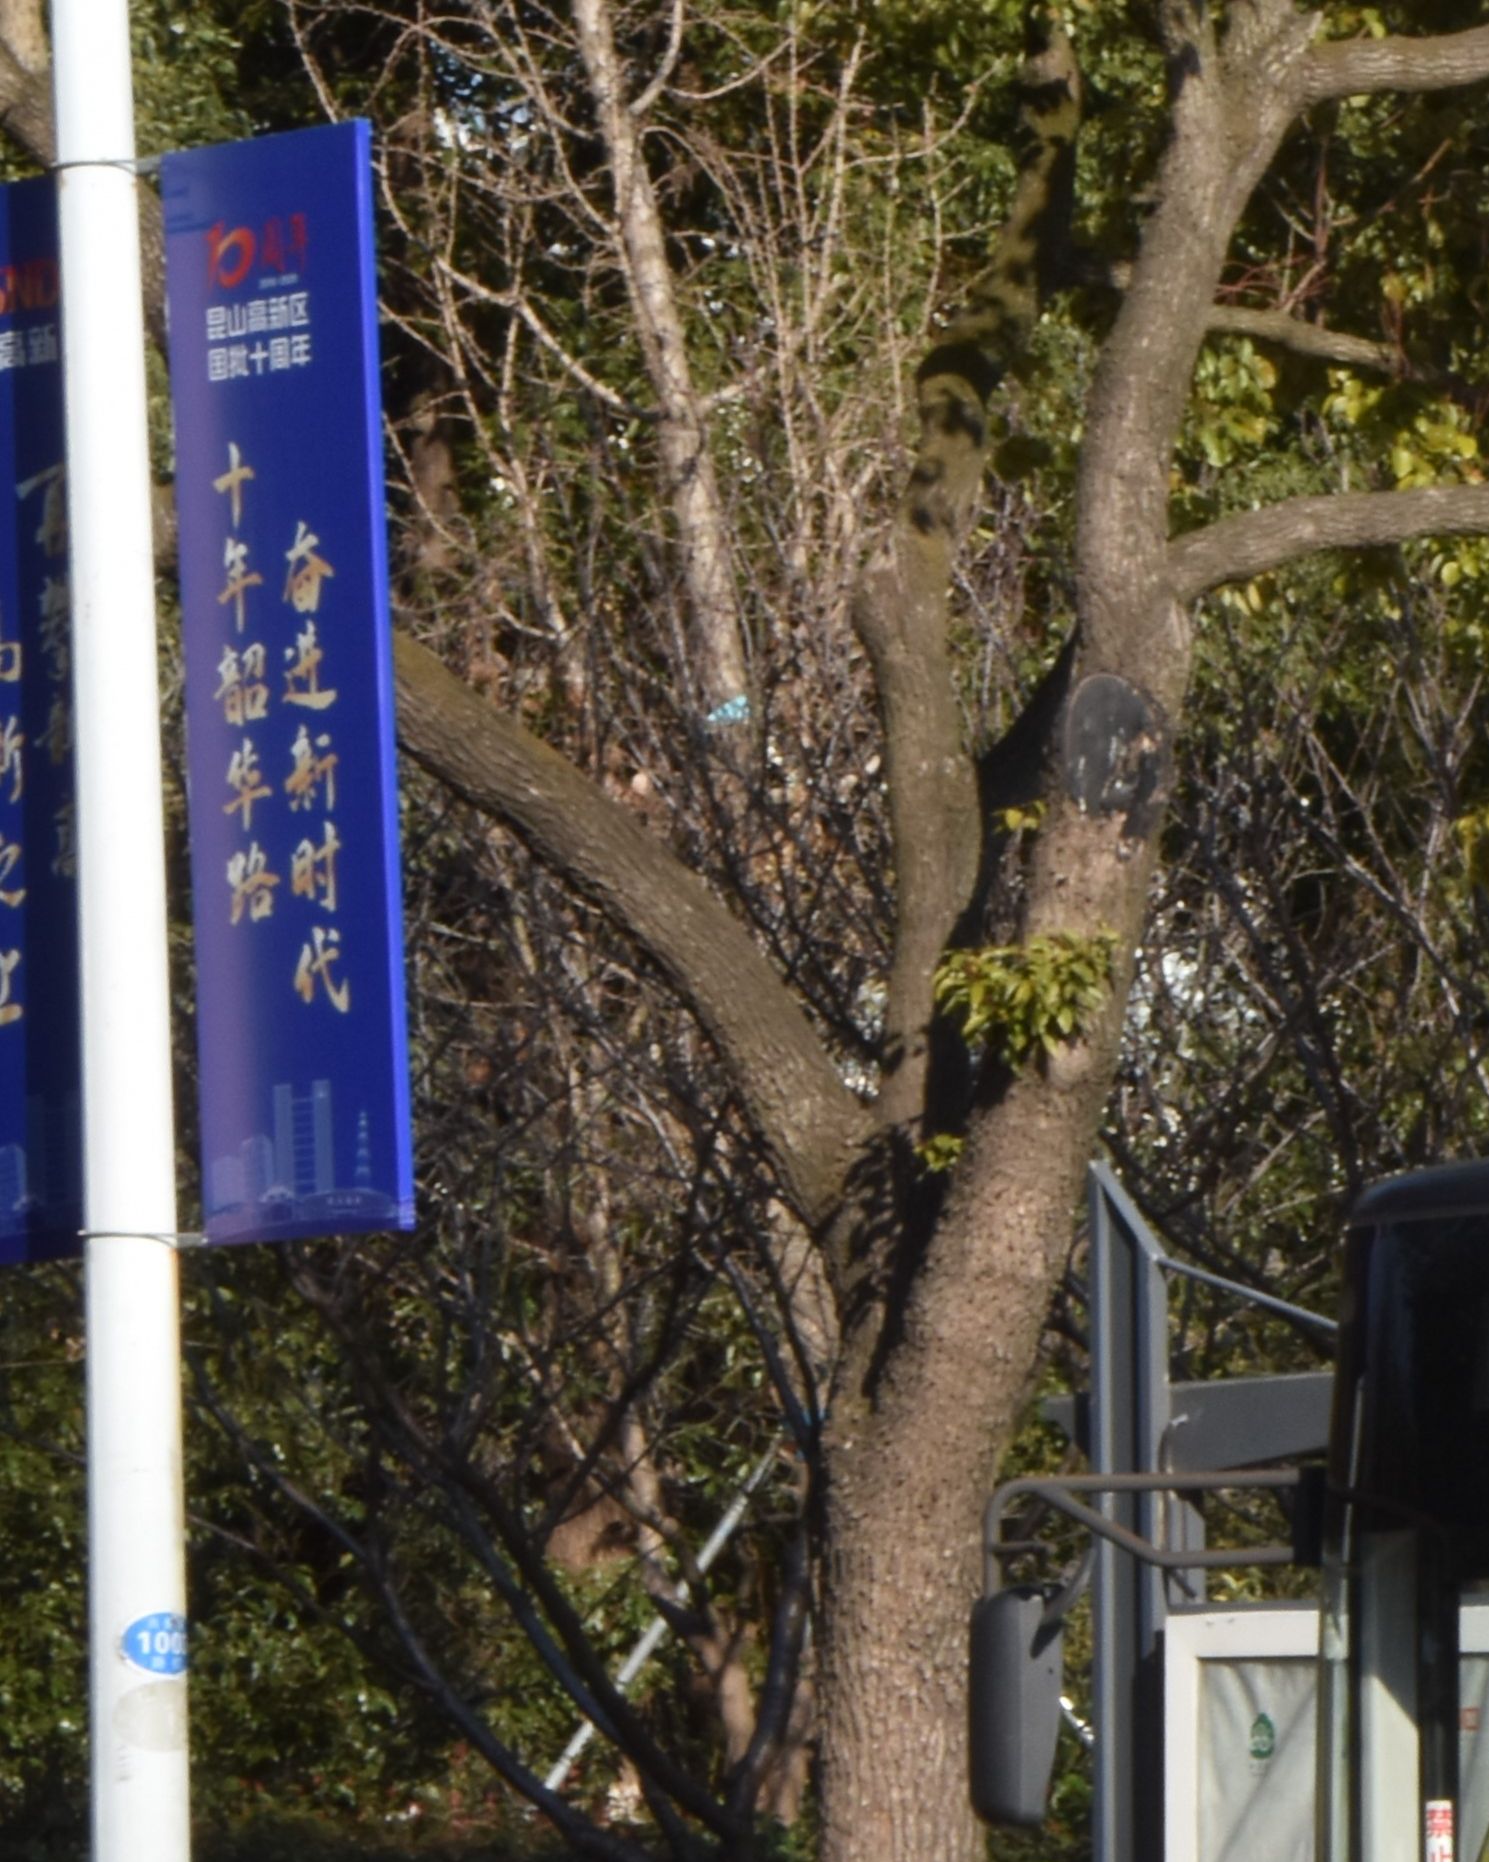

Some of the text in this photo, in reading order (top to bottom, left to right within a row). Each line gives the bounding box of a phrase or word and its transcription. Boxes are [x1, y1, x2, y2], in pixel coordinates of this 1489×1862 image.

[206, 291, 309, 341] 昆山高新区
[282, 520, 350, 1014] 奋进新时代
